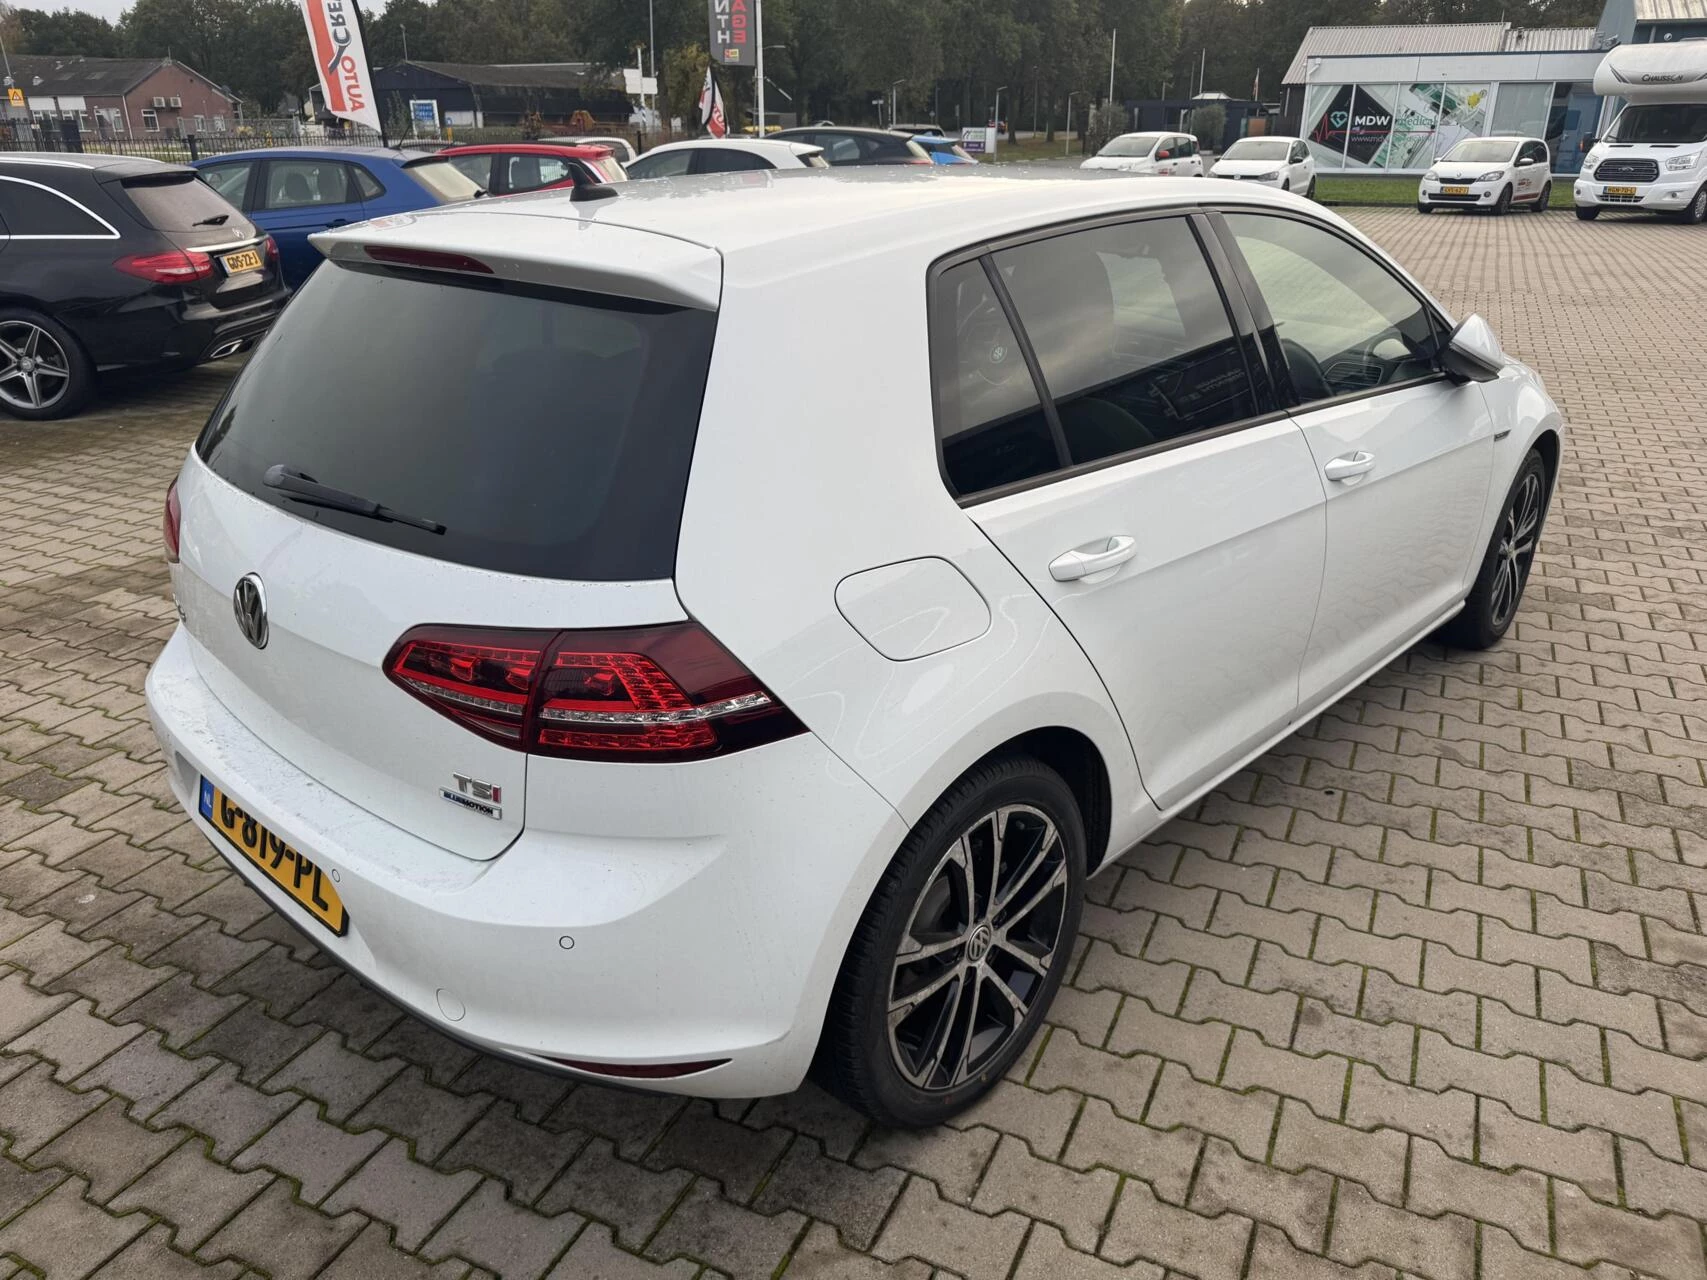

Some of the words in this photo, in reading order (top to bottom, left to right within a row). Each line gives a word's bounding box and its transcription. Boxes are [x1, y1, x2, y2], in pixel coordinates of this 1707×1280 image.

[1354, 115, 1391, 126] MDW
[452, 772, 502, 804] TSI
[220, 793, 329, 911] G-819-PL
